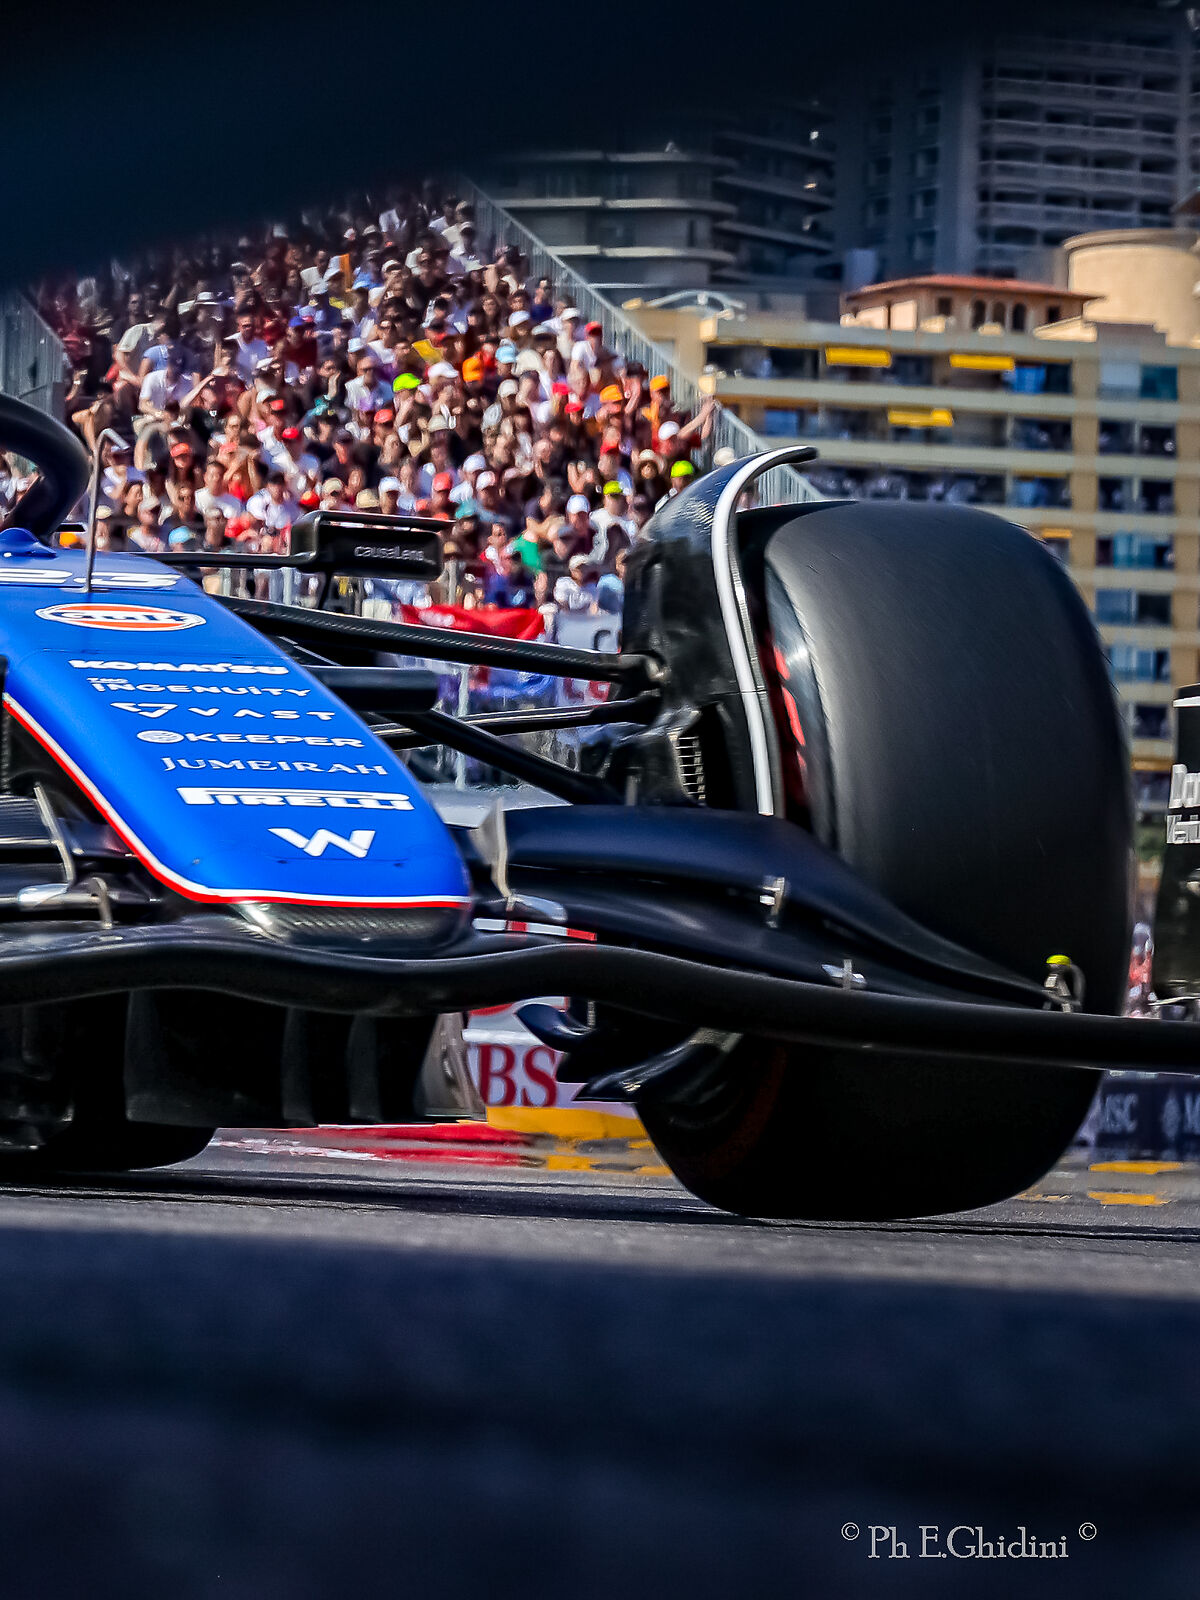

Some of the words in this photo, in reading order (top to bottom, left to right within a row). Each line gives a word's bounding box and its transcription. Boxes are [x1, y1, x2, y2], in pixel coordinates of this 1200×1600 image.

[49, 611, 189, 622] Gulf
[68, 659, 290, 675] KOMATSU
[92, 683, 311, 697] INGENUITY
[188, 707, 336, 721] VAST
[185, 732, 365, 748] KEEPER
[160, 757, 388, 775] JUMEIRAH
[176, 787, 415, 811] PIRELLI
[467, 1043, 557, 1107] BS
